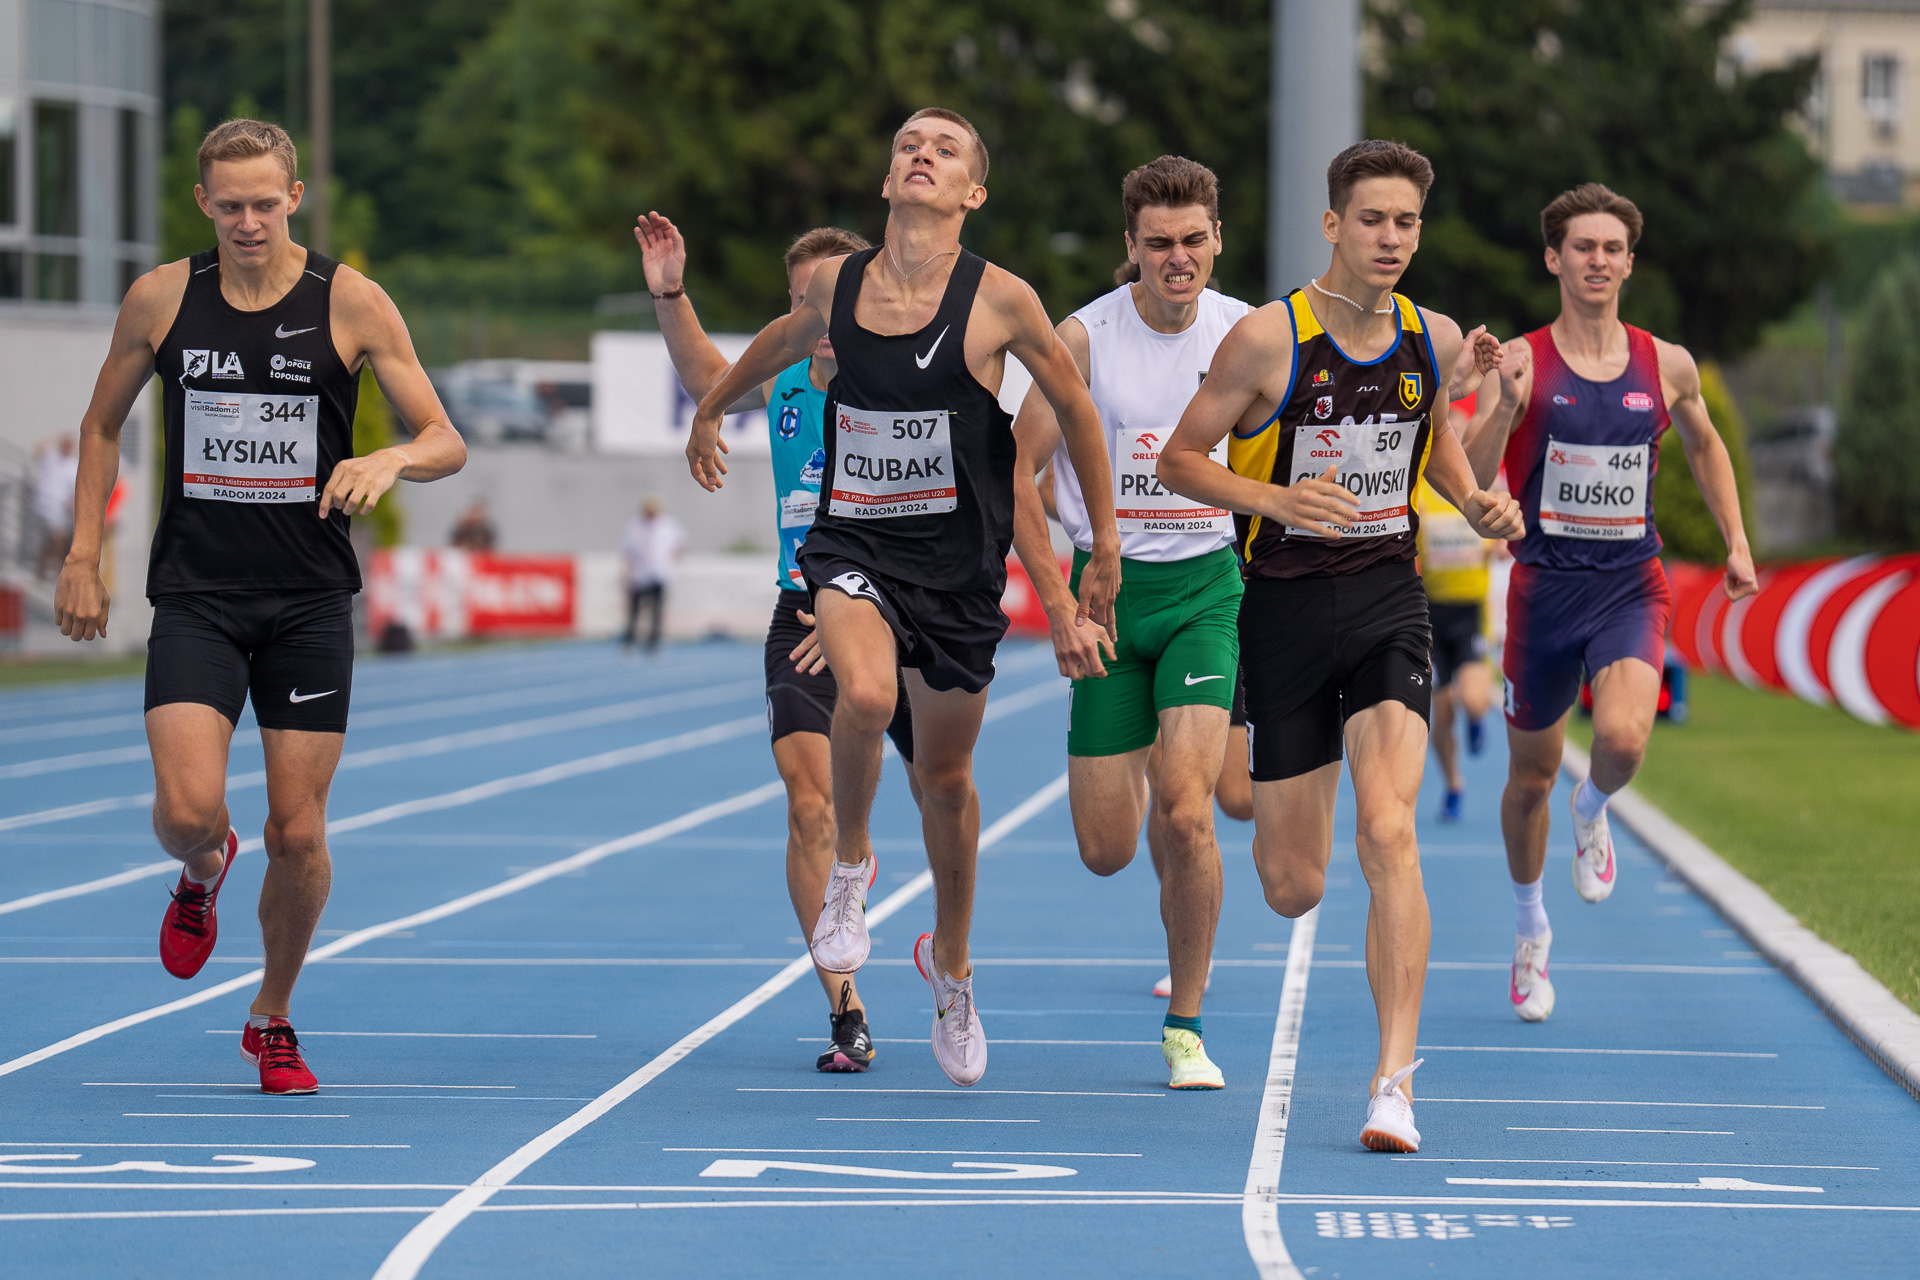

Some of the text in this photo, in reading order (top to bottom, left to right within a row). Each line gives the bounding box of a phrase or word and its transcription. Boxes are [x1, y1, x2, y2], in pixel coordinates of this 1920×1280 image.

[211, 351, 244, 374] LA
[286, 360, 311, 370] OPOLE
[274, 371, 311, 383] OPOLSKIE
[190, 404, 240, 414] visitRadom.pl
[259, 401, 306, 423] 344
[892, 418, 938, 440] 507
[1375, 430, 1401, 452] 50
[202, 437, 298, 464] ŁYSIAK
[1310, 450, 1342, 458] ORLEN
[843, 453, 945, 482] CZUBAK
[1608, 452, 1642, 470] 464
[207, 476, 224, 484] PZLA
[225, 478, 267, 487] Mistrzostwa
[268, 479, 290, 487] Polski
[1121, 474, 1173, 496] PRZ
[1296, 468, 1406, 497] CHOWSKI
[213, 489, 287, 500] RADOM 2024
[841, 492, 851, 501] 78.
[851, 494, 865, 503] PZLA
[865, 495, 908, 504] Mistrzostwa
[909, 491, 930, 500] Polski
[1559, 480, 1634, 505] BUŚKO
[855, 503, 929, 516] RADOM 2024
[1196, 508, 1215, 516] Polski
[1388, 508, 1400, 516] U20
[1144, 521, 1213, 530] RADOM 2024
[1363, 523, 1387, 534] 2024
[1563, 525, 1623, 536] RADOM 2024
[846, 573, 878, 598] 2
[0, 1154, 317, 1174] 3
[700, 1159, 1078, 1179] 2
